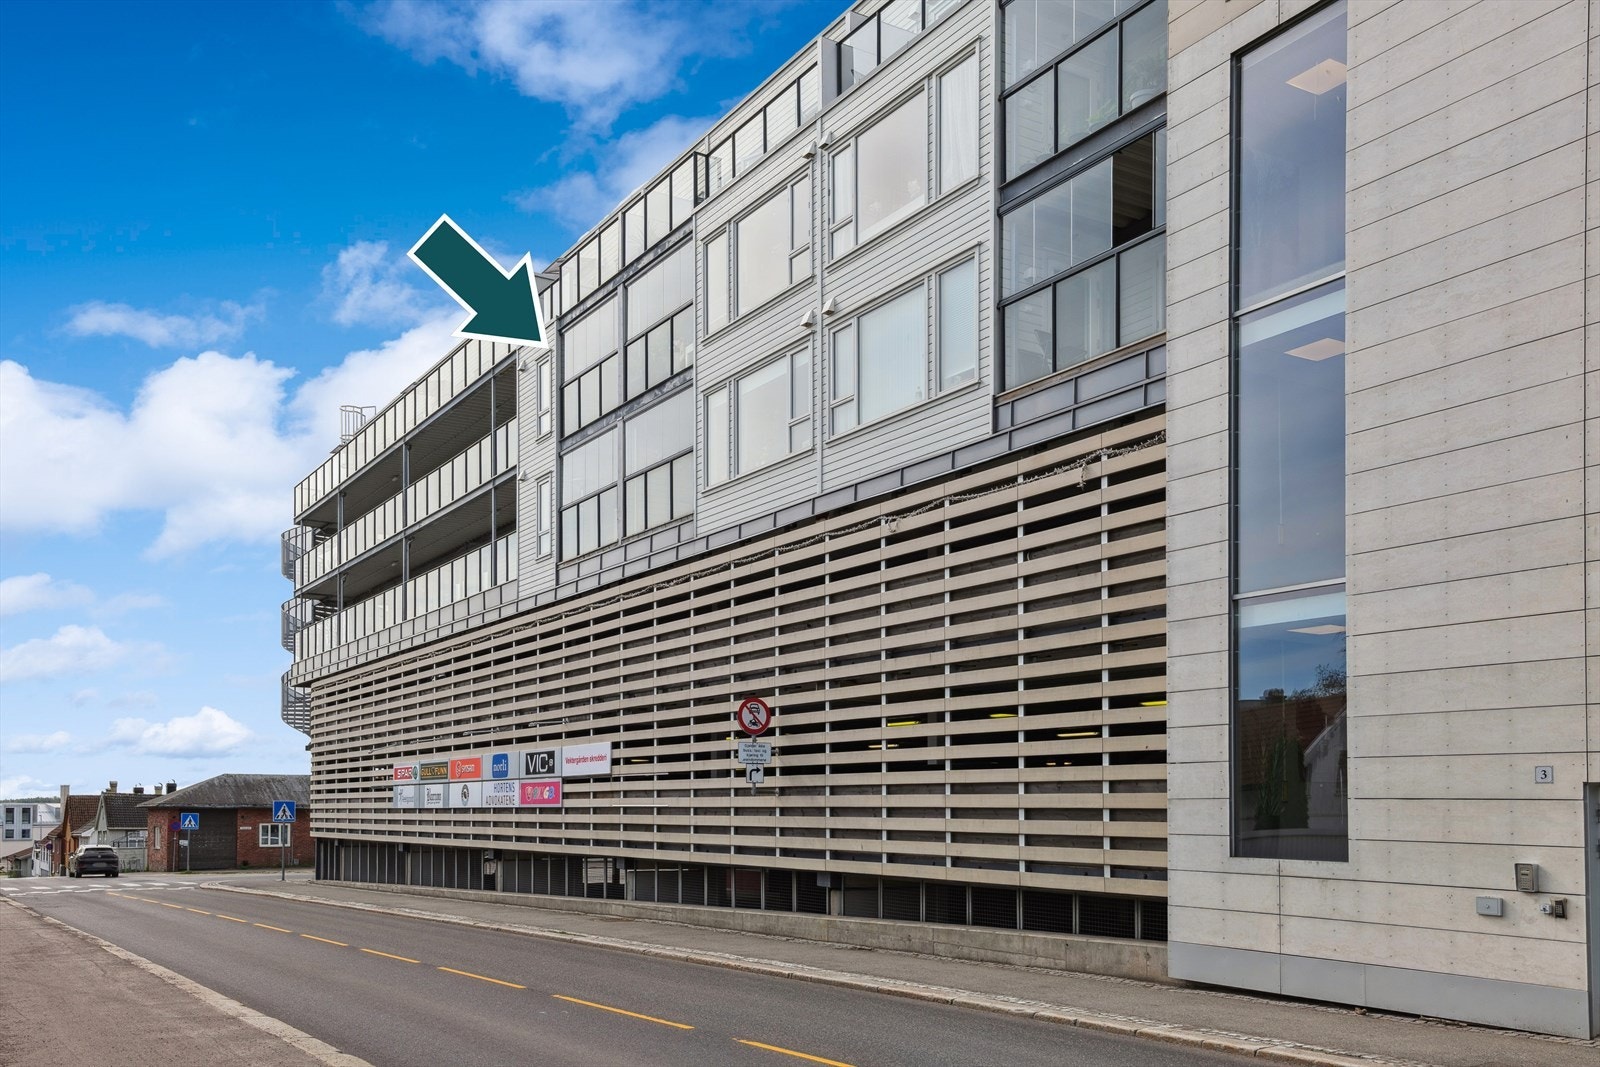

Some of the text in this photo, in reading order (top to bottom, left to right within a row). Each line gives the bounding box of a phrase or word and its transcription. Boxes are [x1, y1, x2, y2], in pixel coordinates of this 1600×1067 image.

[493, 760, 507, 772] norli
[527, 753, 548, 773] VIC
[397, 768, 412, 778] SPAR
[1540, 770, 1547, 780] 3
[493, 782, 515, 793] HORTENS
[485, 795, 515, 806] ADVOKATENE
